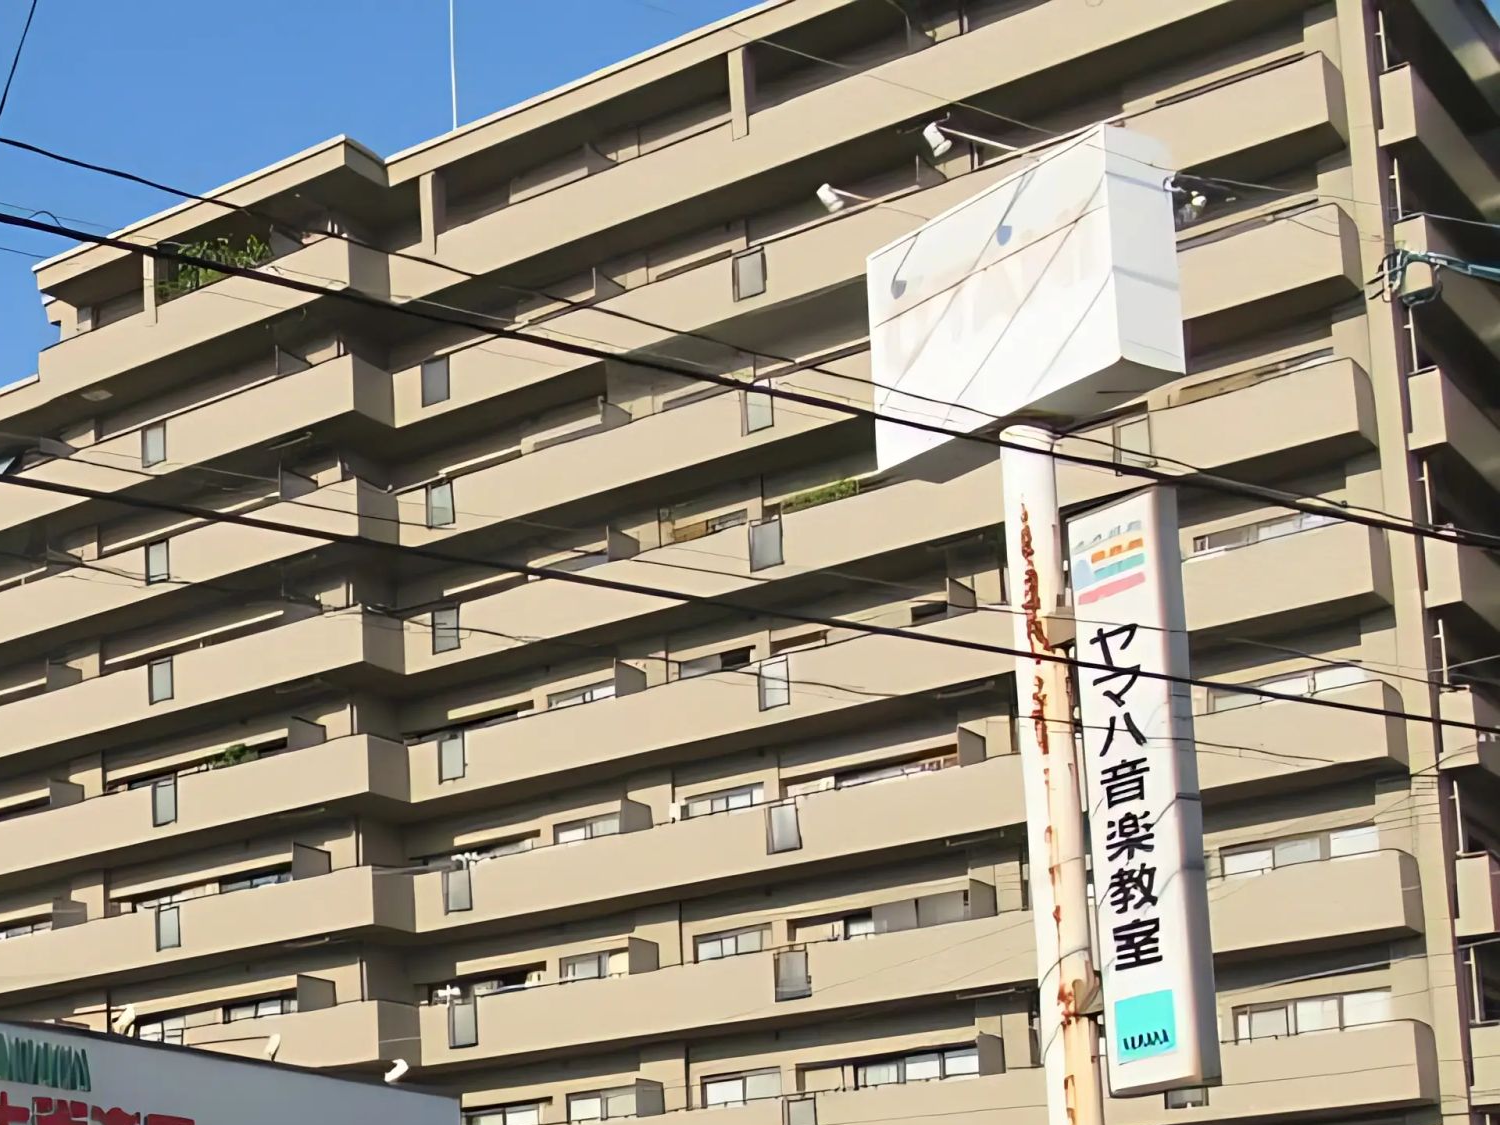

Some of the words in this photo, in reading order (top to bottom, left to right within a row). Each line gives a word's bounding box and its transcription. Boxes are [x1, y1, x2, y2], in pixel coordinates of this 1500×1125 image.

[1089, 622, 1163, 972] ヤマハ音楽教室
